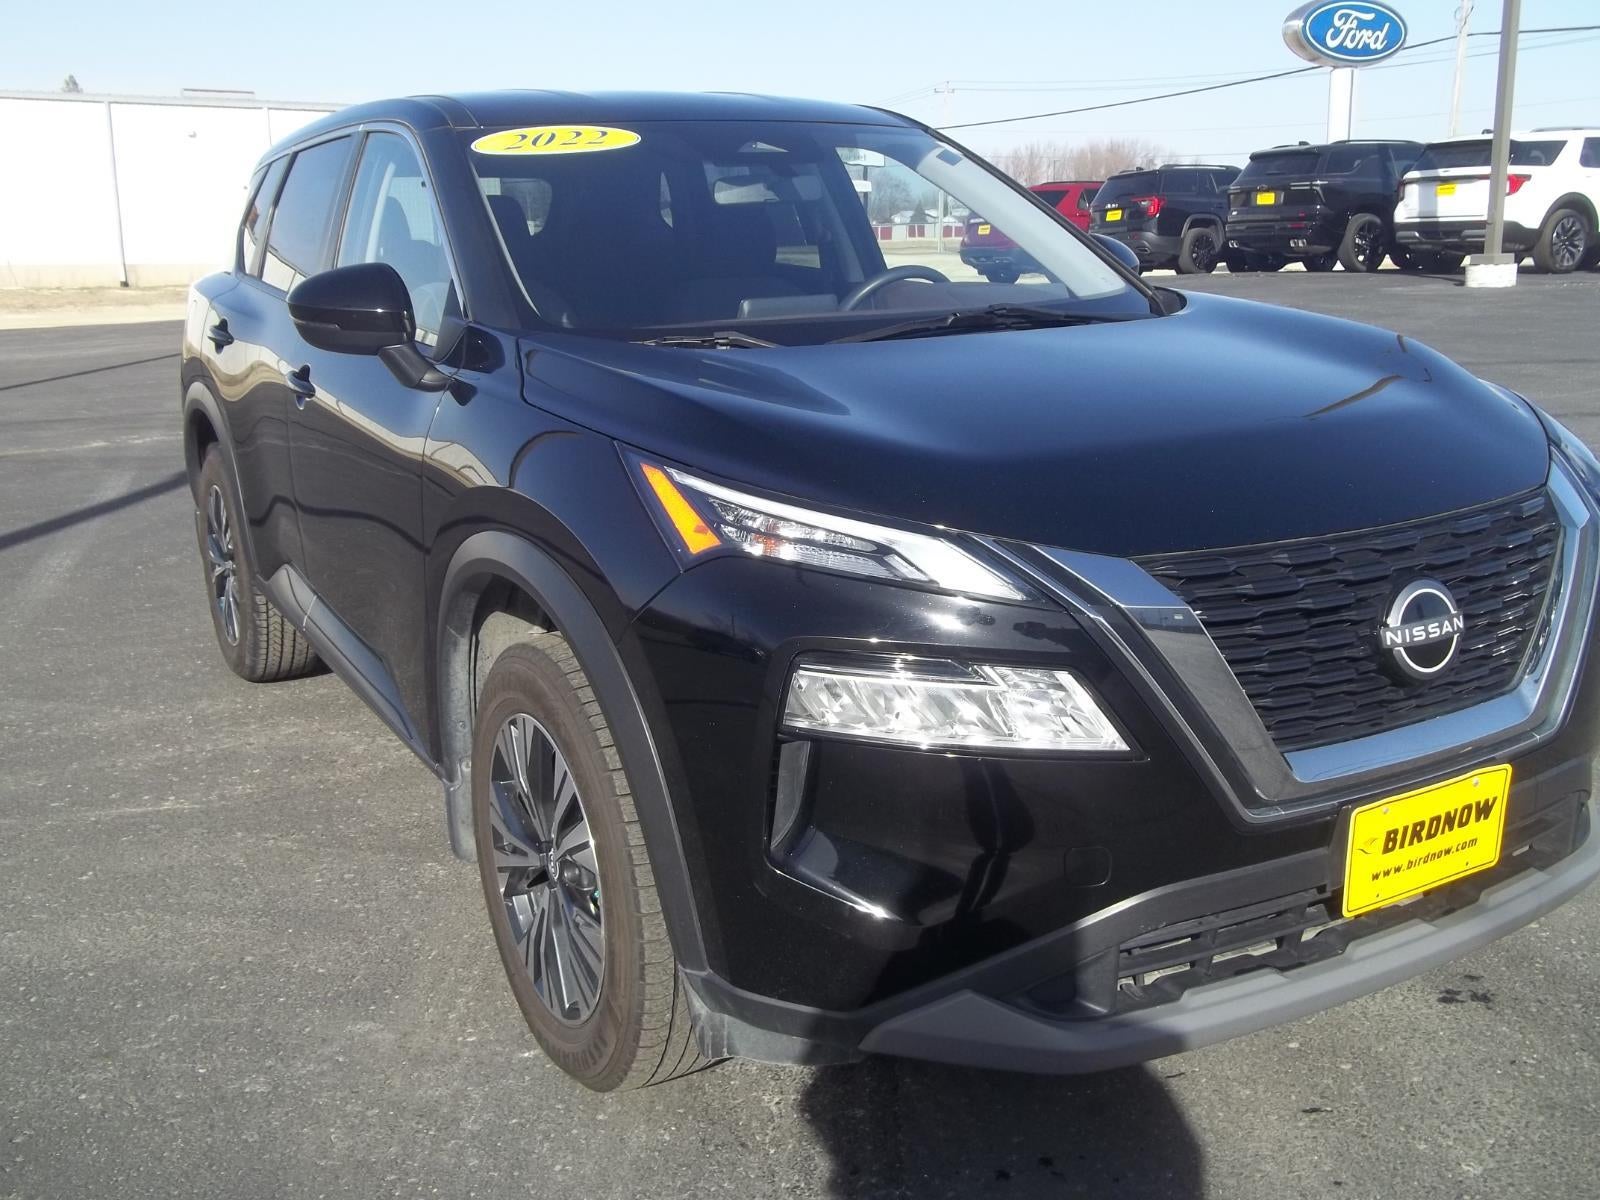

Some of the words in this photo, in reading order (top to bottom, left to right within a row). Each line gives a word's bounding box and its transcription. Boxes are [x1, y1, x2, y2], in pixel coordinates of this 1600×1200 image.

[1326, 9, 1390, 50] Ford
[504, 131, 608, 150] 2022
[1385, 615, 1464, 645] NISSAN
[1381, 796, 1498, 855] BIRDNOW
[1371, 837, 1478, 882] www.birdnow.com
